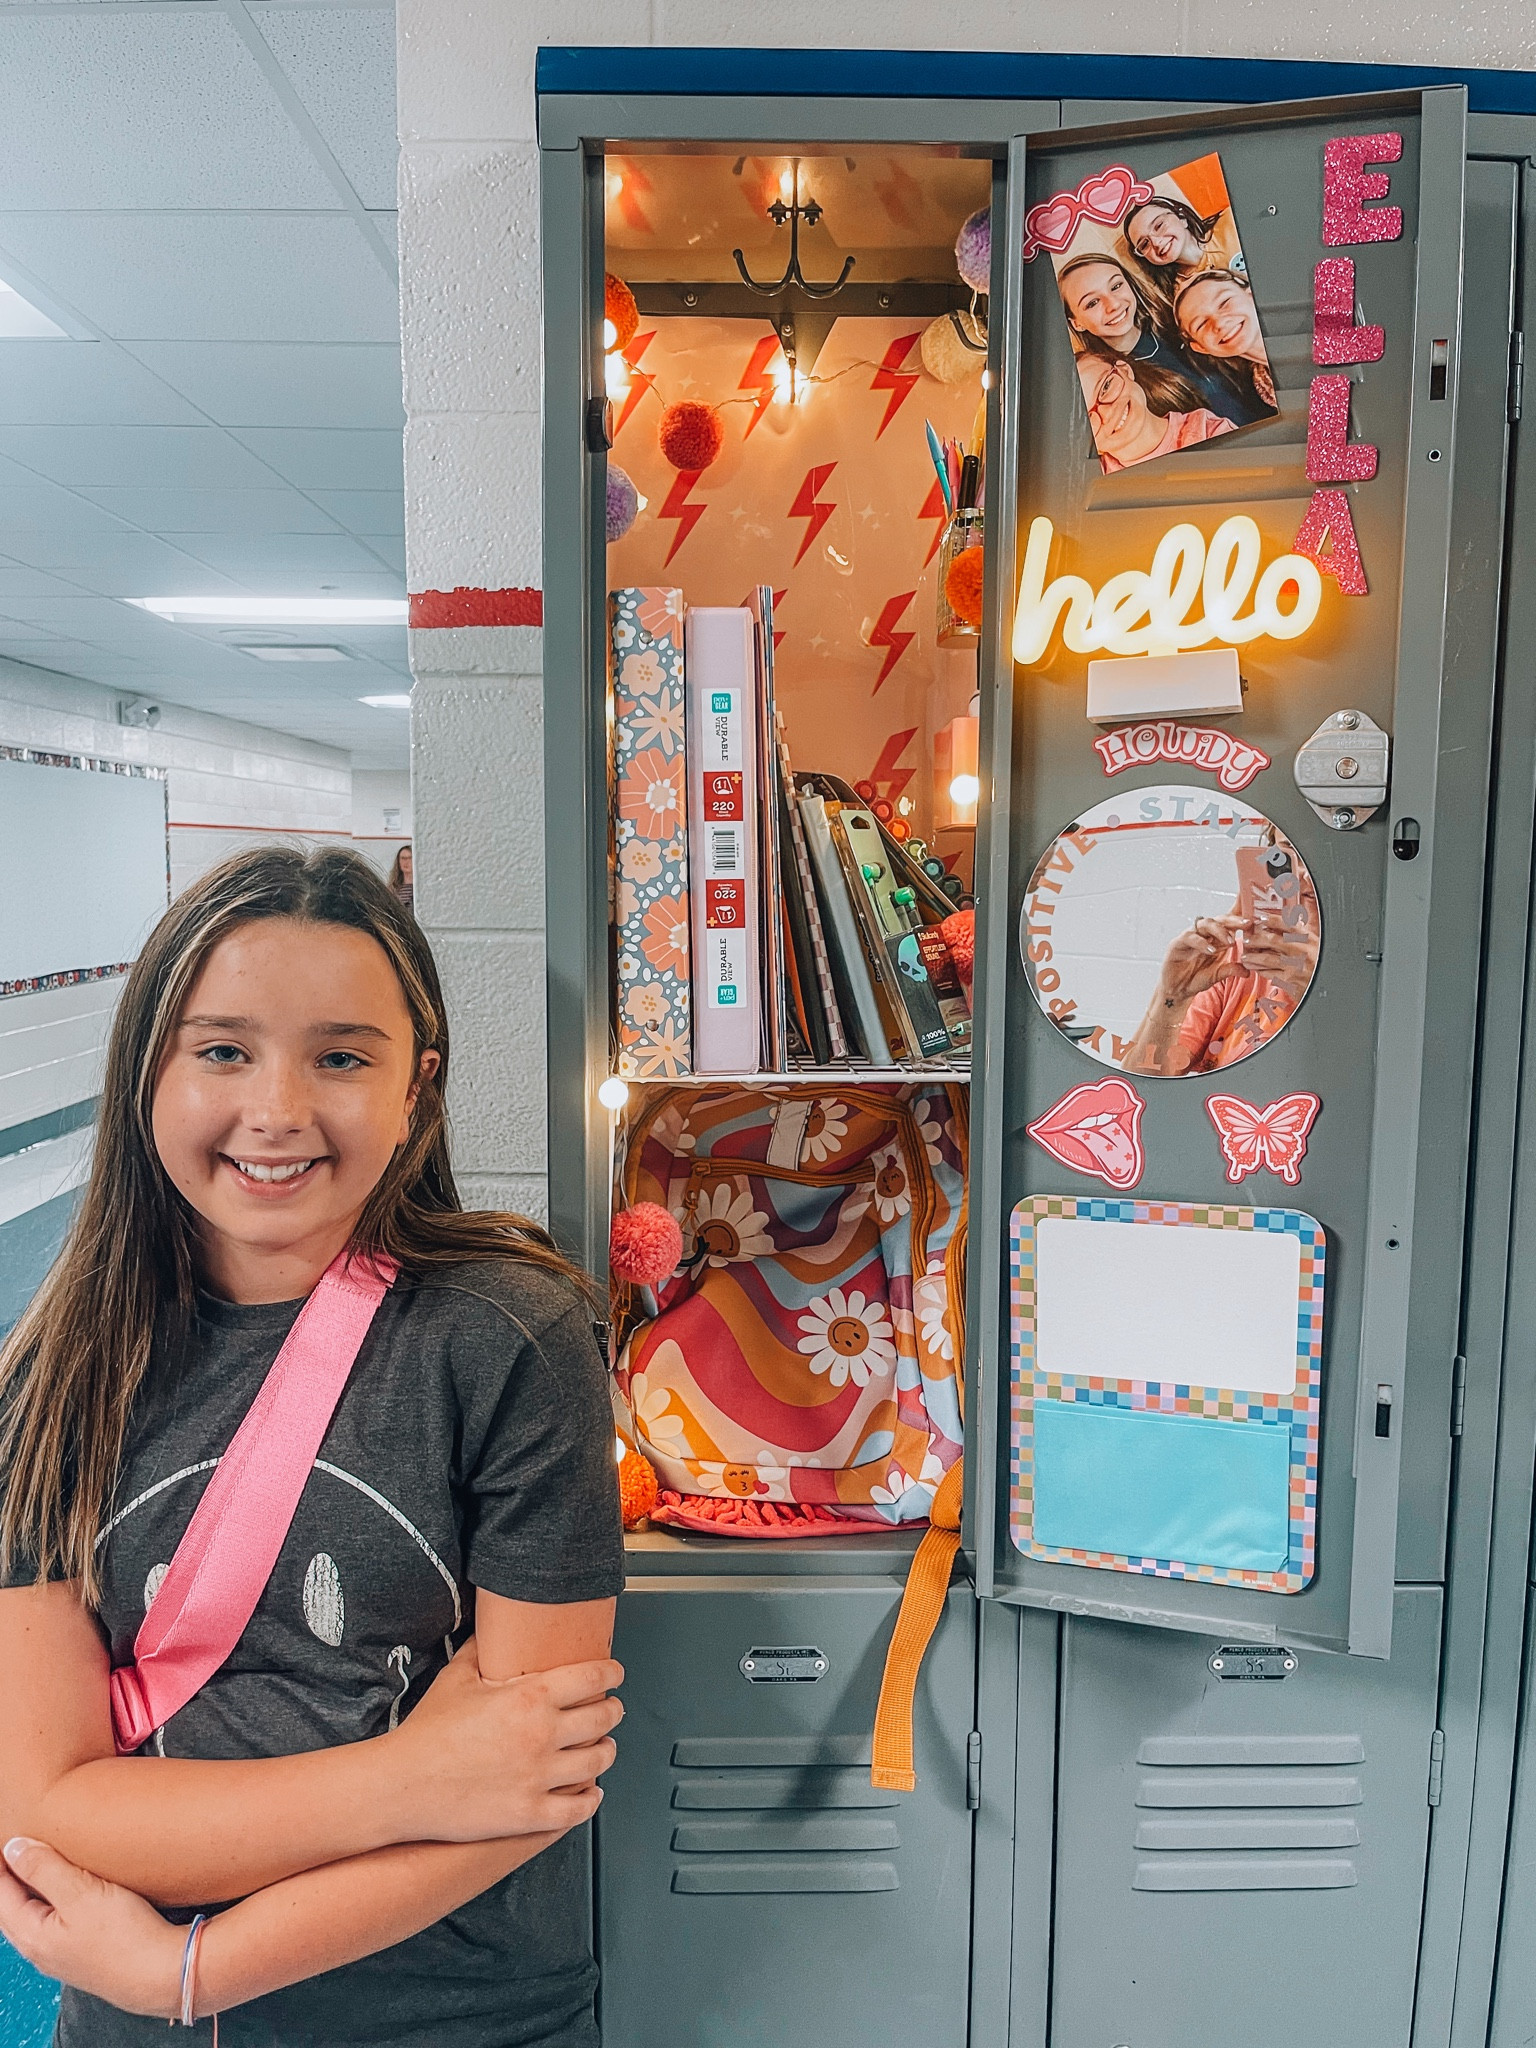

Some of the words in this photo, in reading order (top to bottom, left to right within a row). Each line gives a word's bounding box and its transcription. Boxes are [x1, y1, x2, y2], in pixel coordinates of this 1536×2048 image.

[1291, 131, 1402, 596] ELLA
[1012, 515, 1322, 664] hello
[720, 716, 729, 761] DURABLE
[1096, 723, 1267, 788] HOWDY
[712, 801, 735, 811] 220
[1138, 796, 1250, 840] STAY
[714, 889, 737, 899] 220
[1027, 825, 1099, 1021] POSITIVE
[719, 938, 728, 982] DURABLE
[926, 1028, 946, 1040] 100%
[1080, 1025, 1192, 1073] STAY
